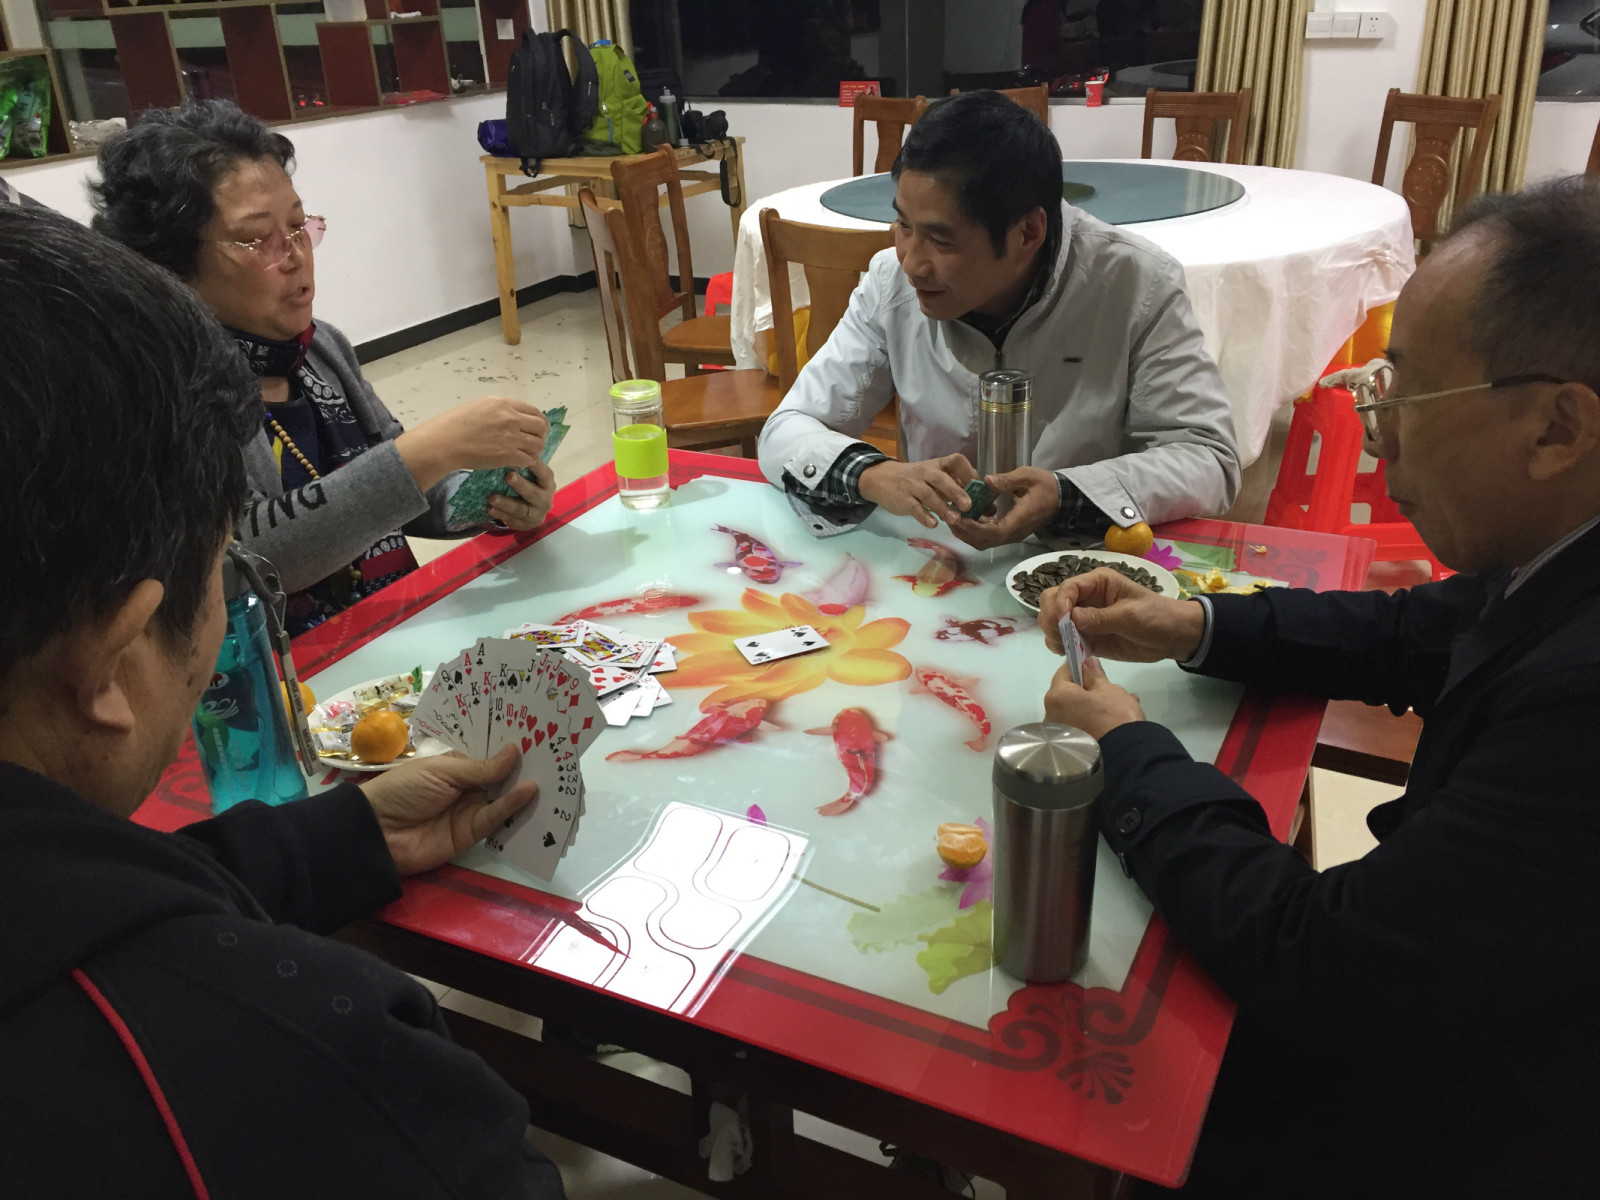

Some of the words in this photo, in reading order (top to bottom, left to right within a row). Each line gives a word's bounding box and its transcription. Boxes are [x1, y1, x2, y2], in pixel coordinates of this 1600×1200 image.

[477, 642, 485, 656] A
[464, 652, 472, 667] A
[528, 659, 535, 672] J
[540, 653, 549, 666] J
[553, 660, 563, 671] J
[441, 669, 451, 683] Q
[499, 663, 508, 677] K
[483, 671, 491, 686] K
[569, 677, 580, 690] 9
[471, 682, 479, 696] K
[455, 693, 466, 708] K
[495, 697, 503, 711] 10
[506, 703, 514, 717] 10
[519, 705, 528, 719] 10
[556, 736, 567, 746] 4
[563, 751, 574, 761] 4
[566, 762, 577, 772] 3
[567, 774, 578, 784] 3
[565, 786, 577, 796] 2
[560, 810, 571, 821] 2
